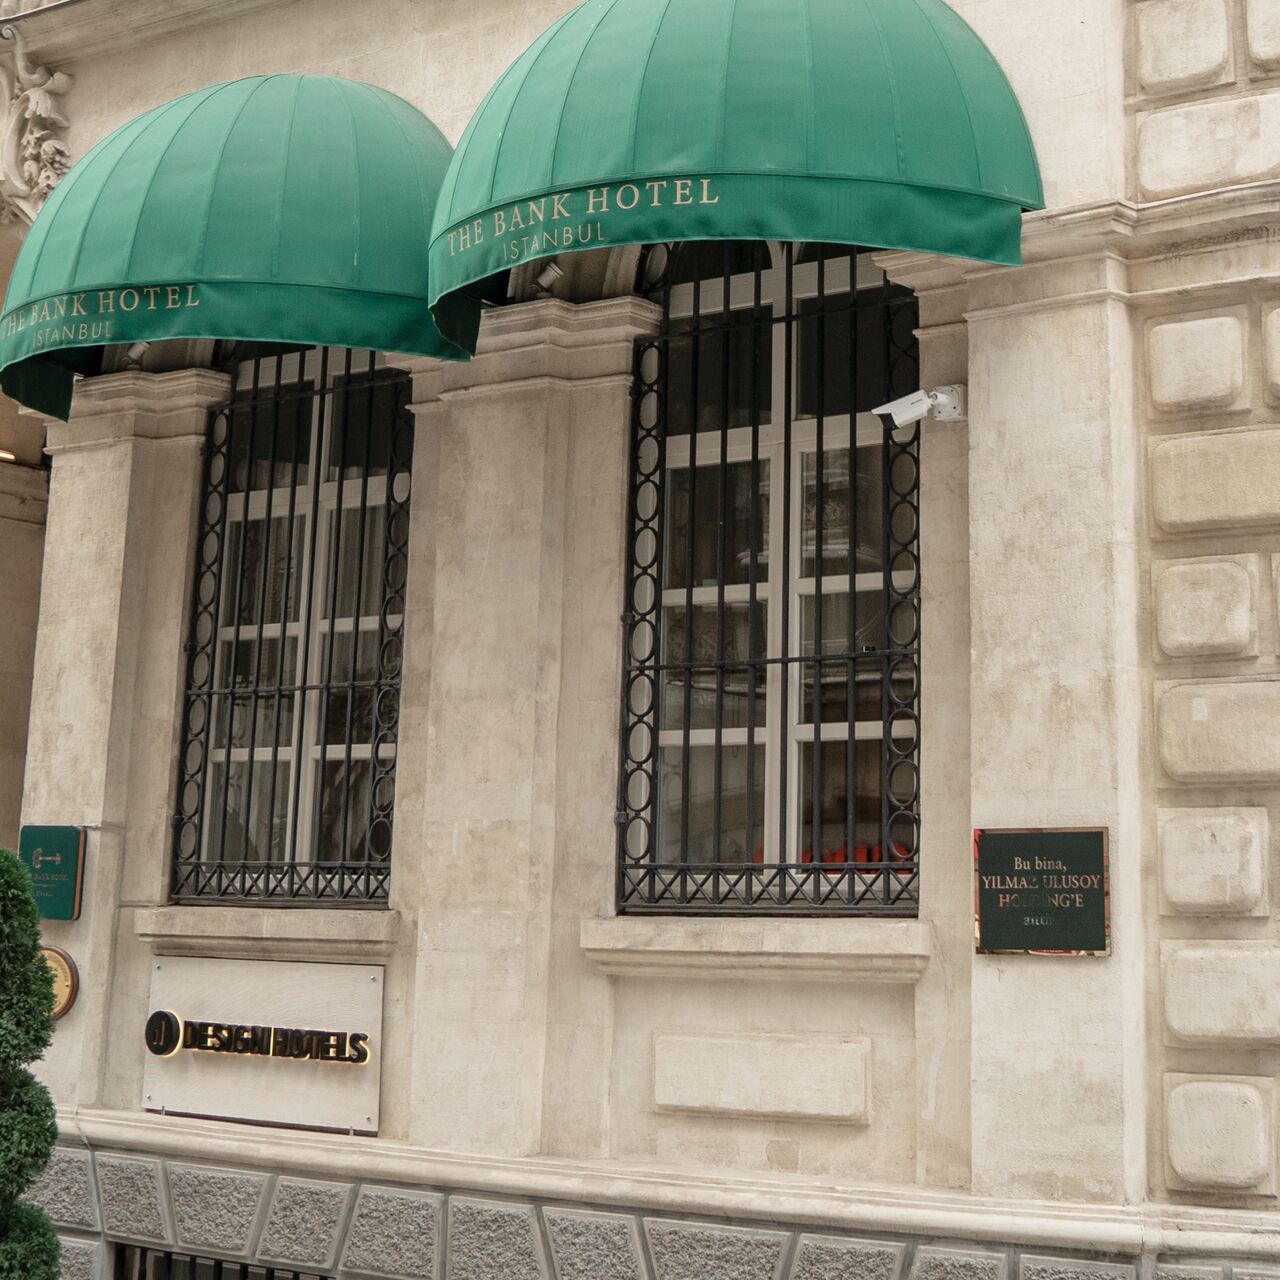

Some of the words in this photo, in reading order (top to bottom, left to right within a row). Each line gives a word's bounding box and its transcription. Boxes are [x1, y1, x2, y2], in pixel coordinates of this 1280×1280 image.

[447, 218, 485, 257] THE
[494, 193, 571, 237] BANK
[586, 179, 720, 214] HOTEL
[502, 221, 605, 261] ISTANBUL
[30, 292, 88, 326] BANK
[98, 285, 200, 314] HOTEL
[982, 875, 1039, 889] YILMAZ
[1043, 874, 1100, 889] ULUSOY
[1014, 856, 1030, 870] Bu
[1035, 856, 1067, 872] bina,
[183, 1020, 272, 1056] DESIGN
[272, 1027, 370, 1064] HOTELS
